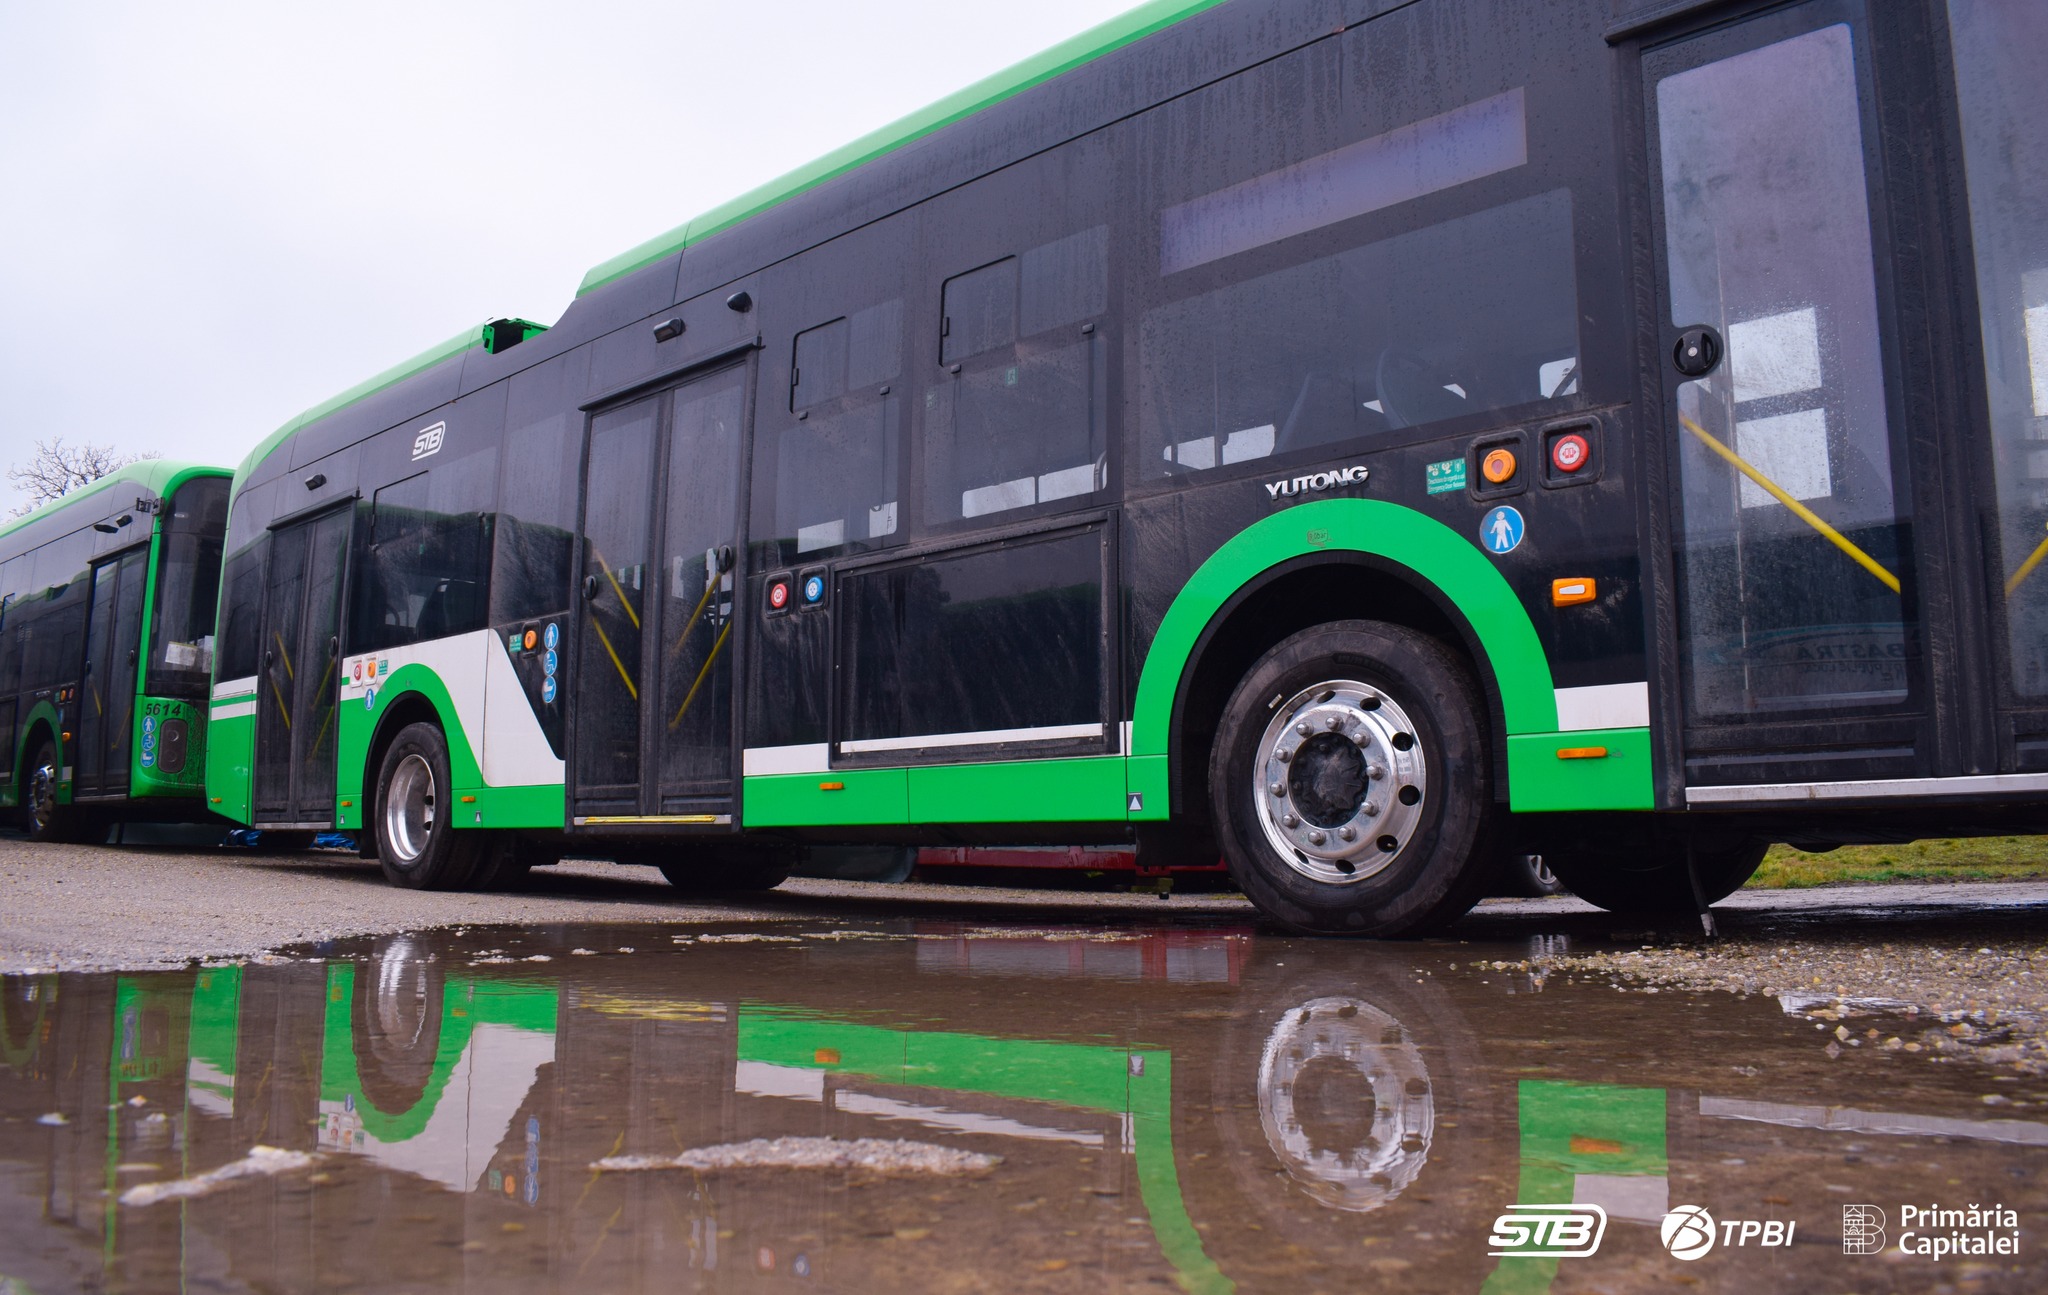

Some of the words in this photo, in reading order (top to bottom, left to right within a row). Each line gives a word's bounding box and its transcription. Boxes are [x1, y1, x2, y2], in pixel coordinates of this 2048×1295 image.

[412, 427, 443, 456] STB
[1265, 465, 1370, 500] YUTONG
[145, 703, 182, 716] 5614
